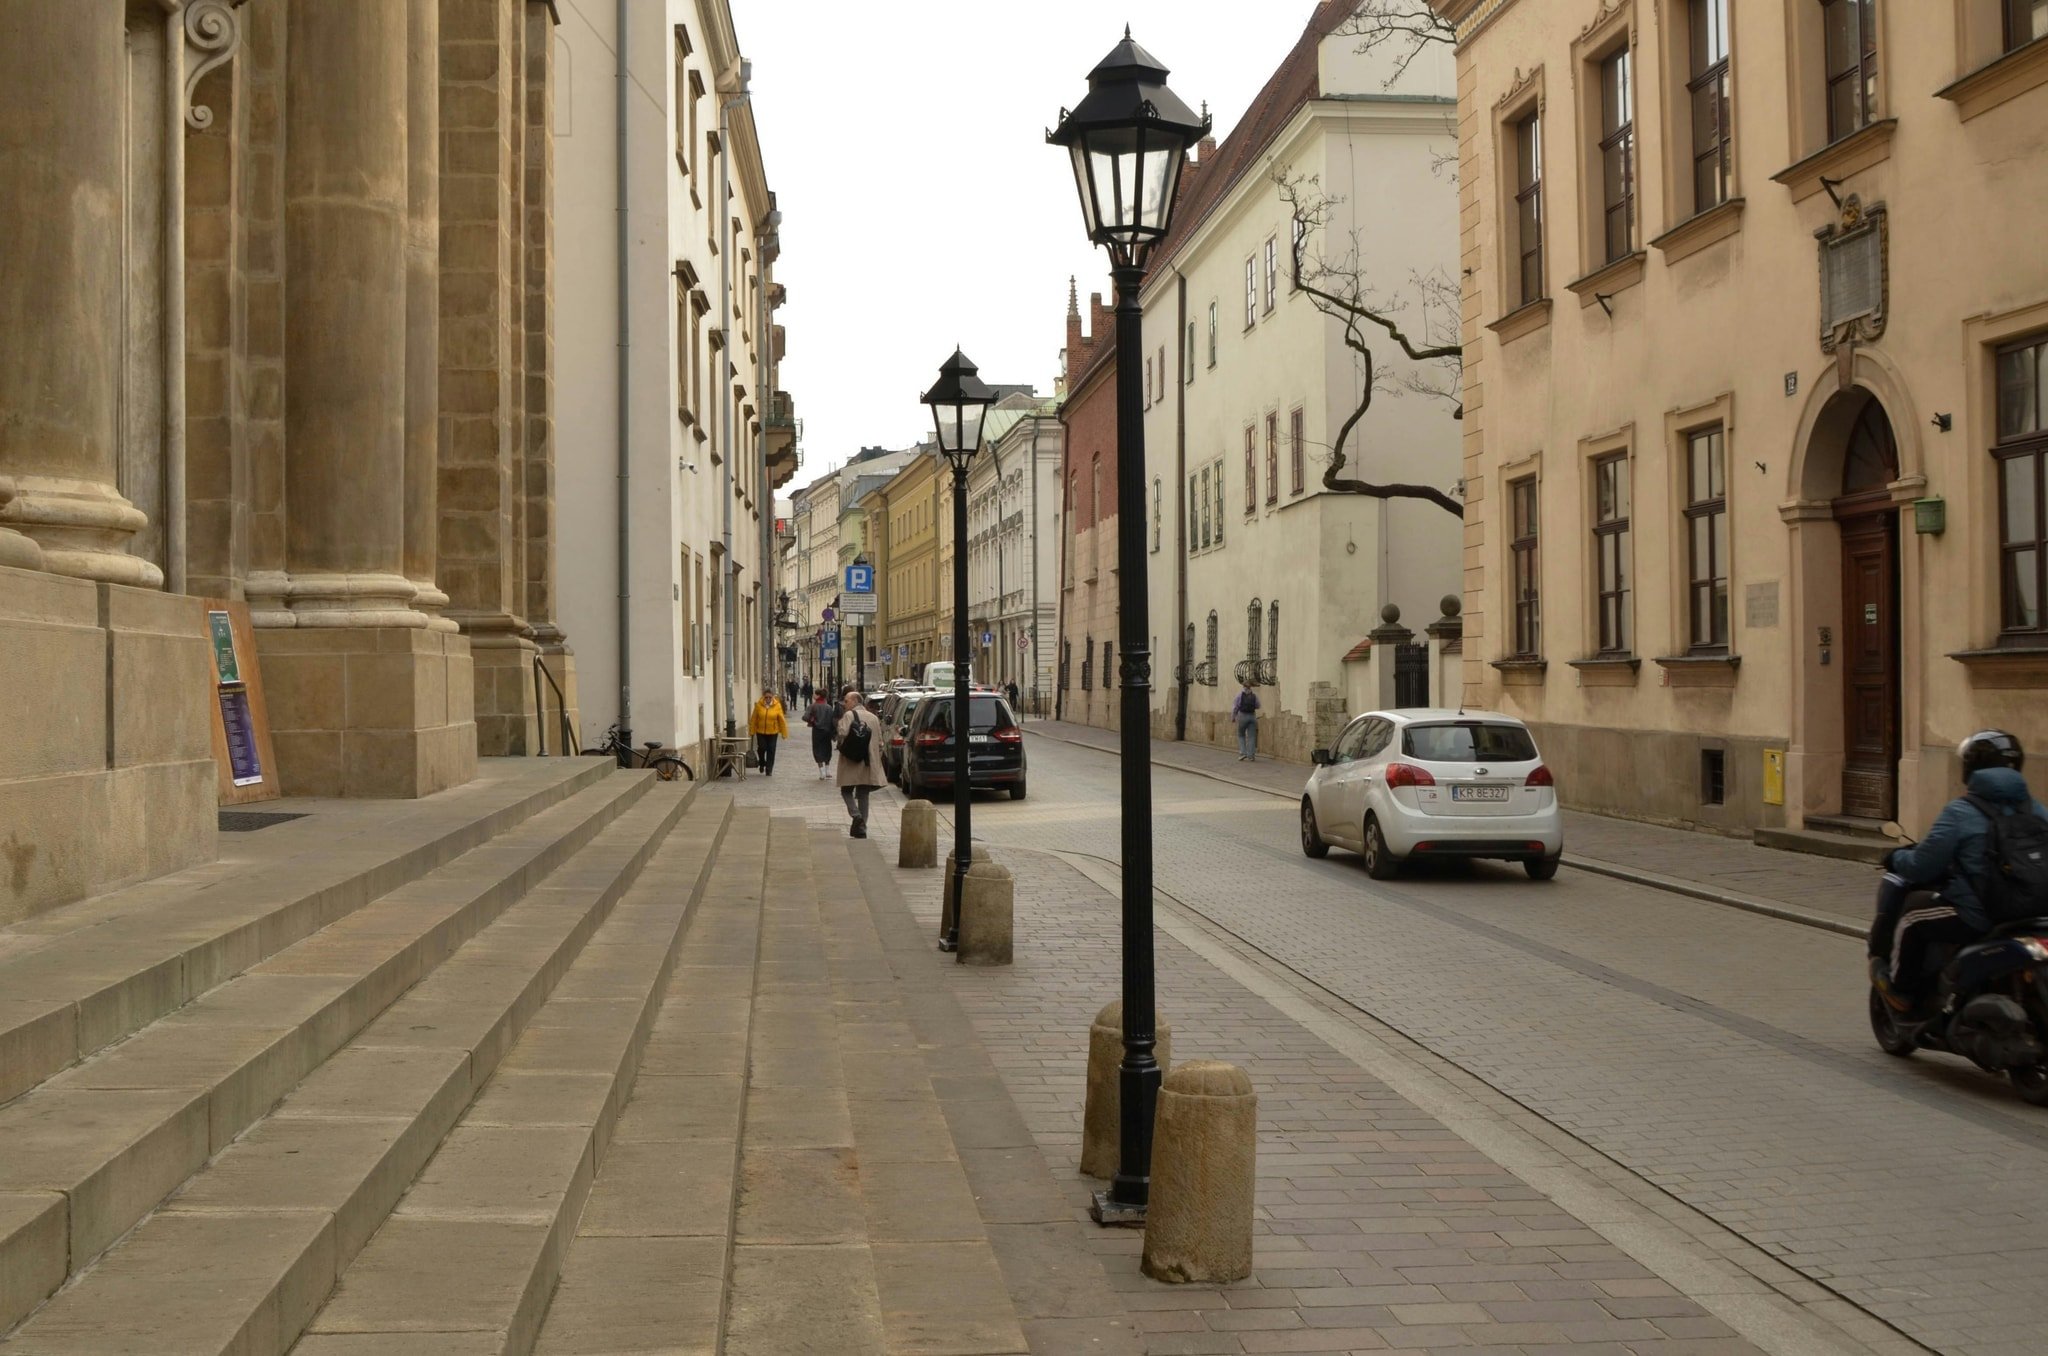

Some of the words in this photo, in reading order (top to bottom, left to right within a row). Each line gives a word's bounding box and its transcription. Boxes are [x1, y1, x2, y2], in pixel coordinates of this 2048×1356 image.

[851, 569, 866, 589] P
[827, 633, 835, 643] P
[1459, 788, 1474, 798] KR
[1477, 788, 1505, 798] 8E327
